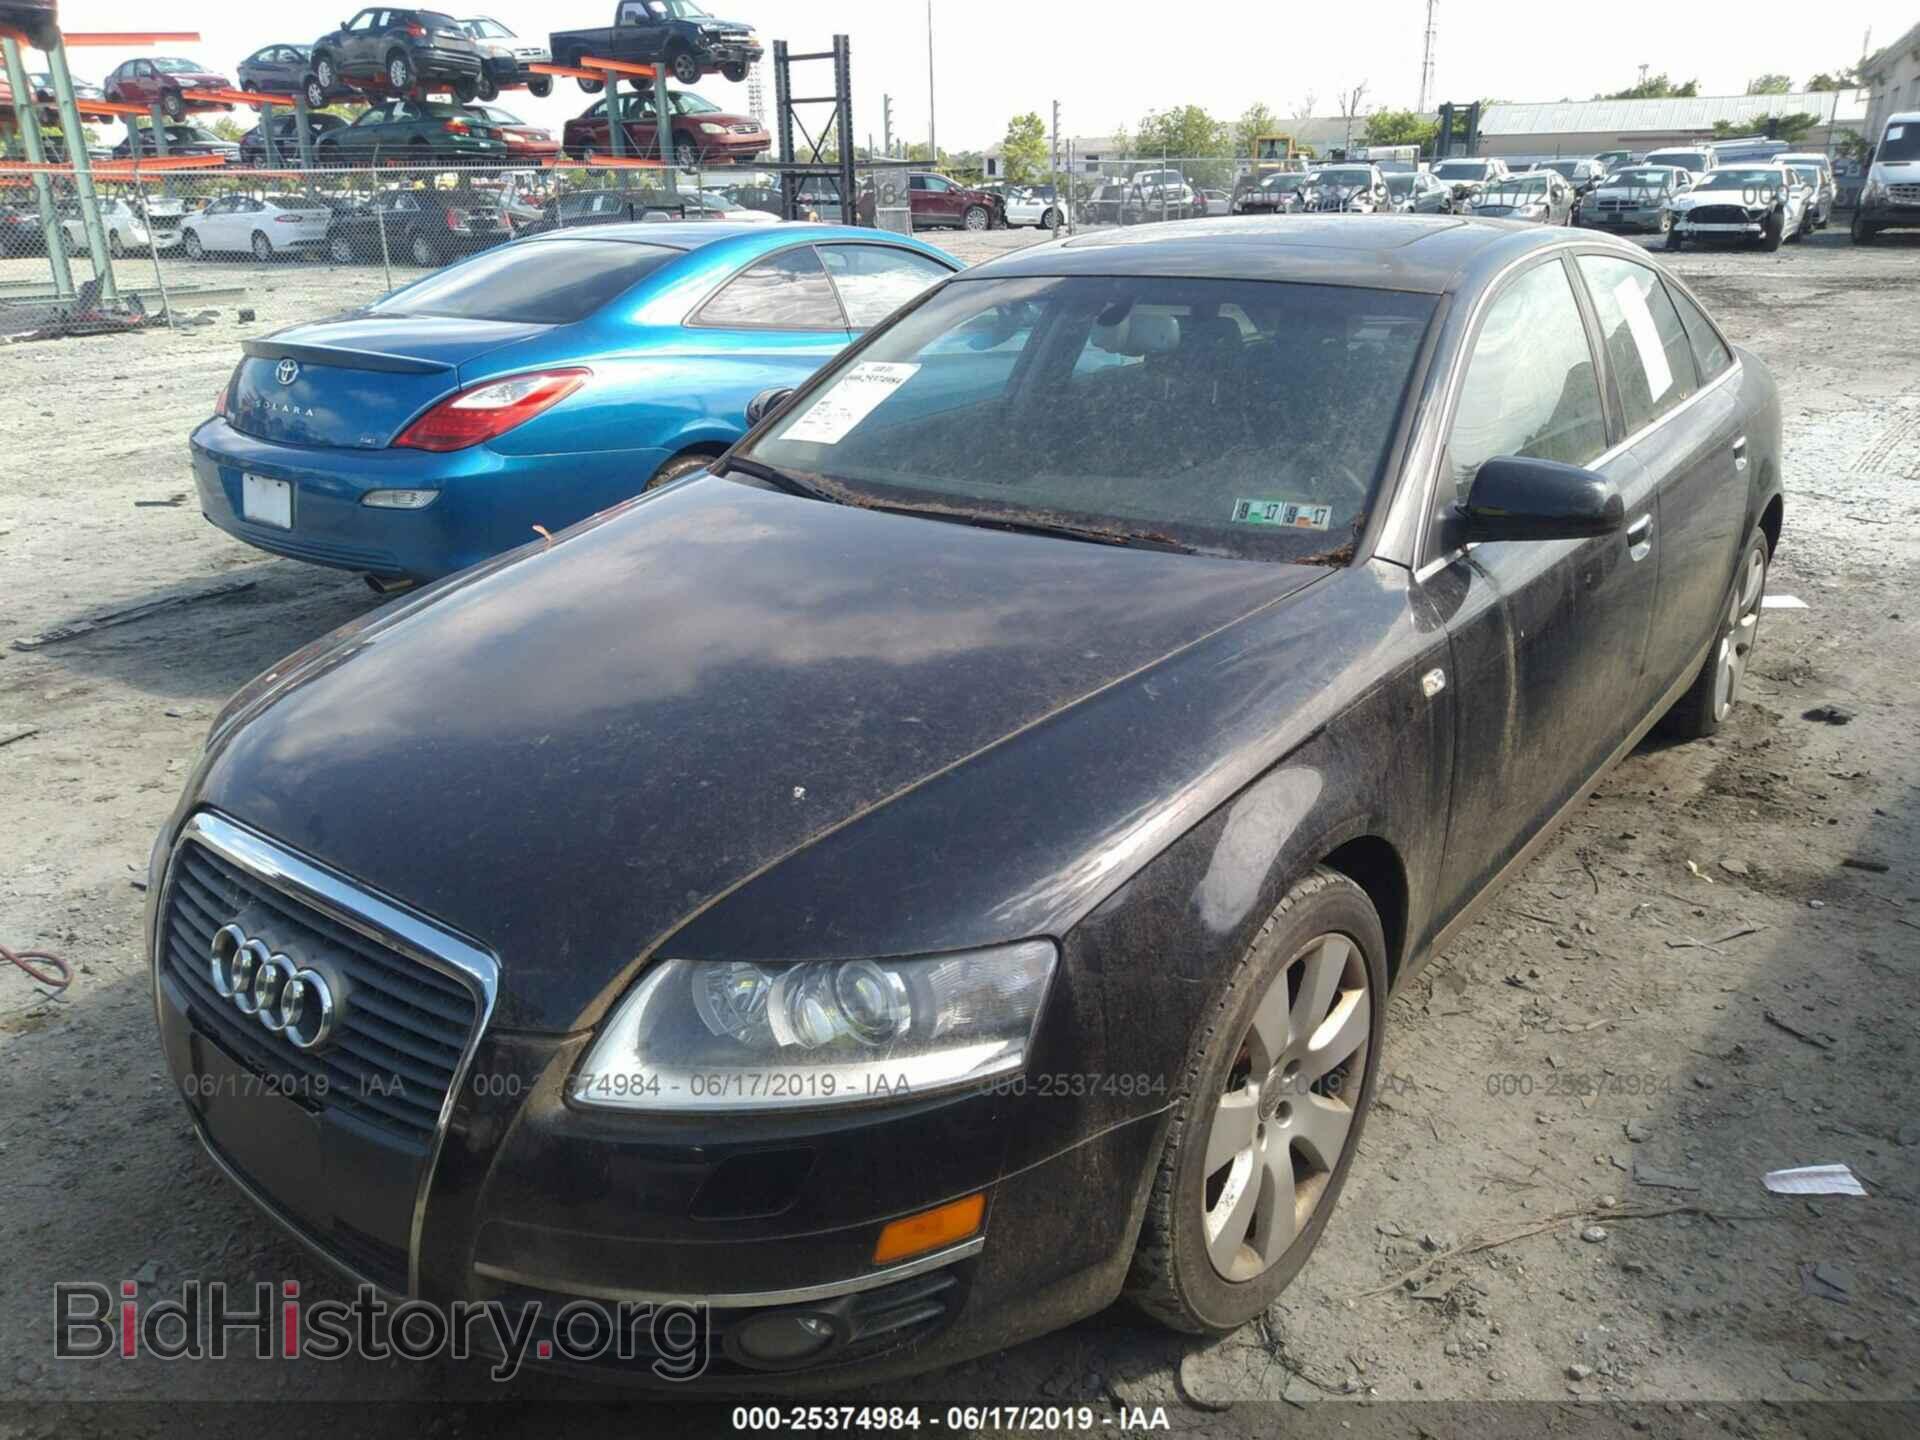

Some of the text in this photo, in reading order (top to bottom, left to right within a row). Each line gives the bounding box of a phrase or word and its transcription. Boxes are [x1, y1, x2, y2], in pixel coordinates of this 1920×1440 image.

[255, 400, 313, 417] SOLARA
[1239, 502, 1279, 520] 9 17
[1313, 508, 1327, 525] 17
